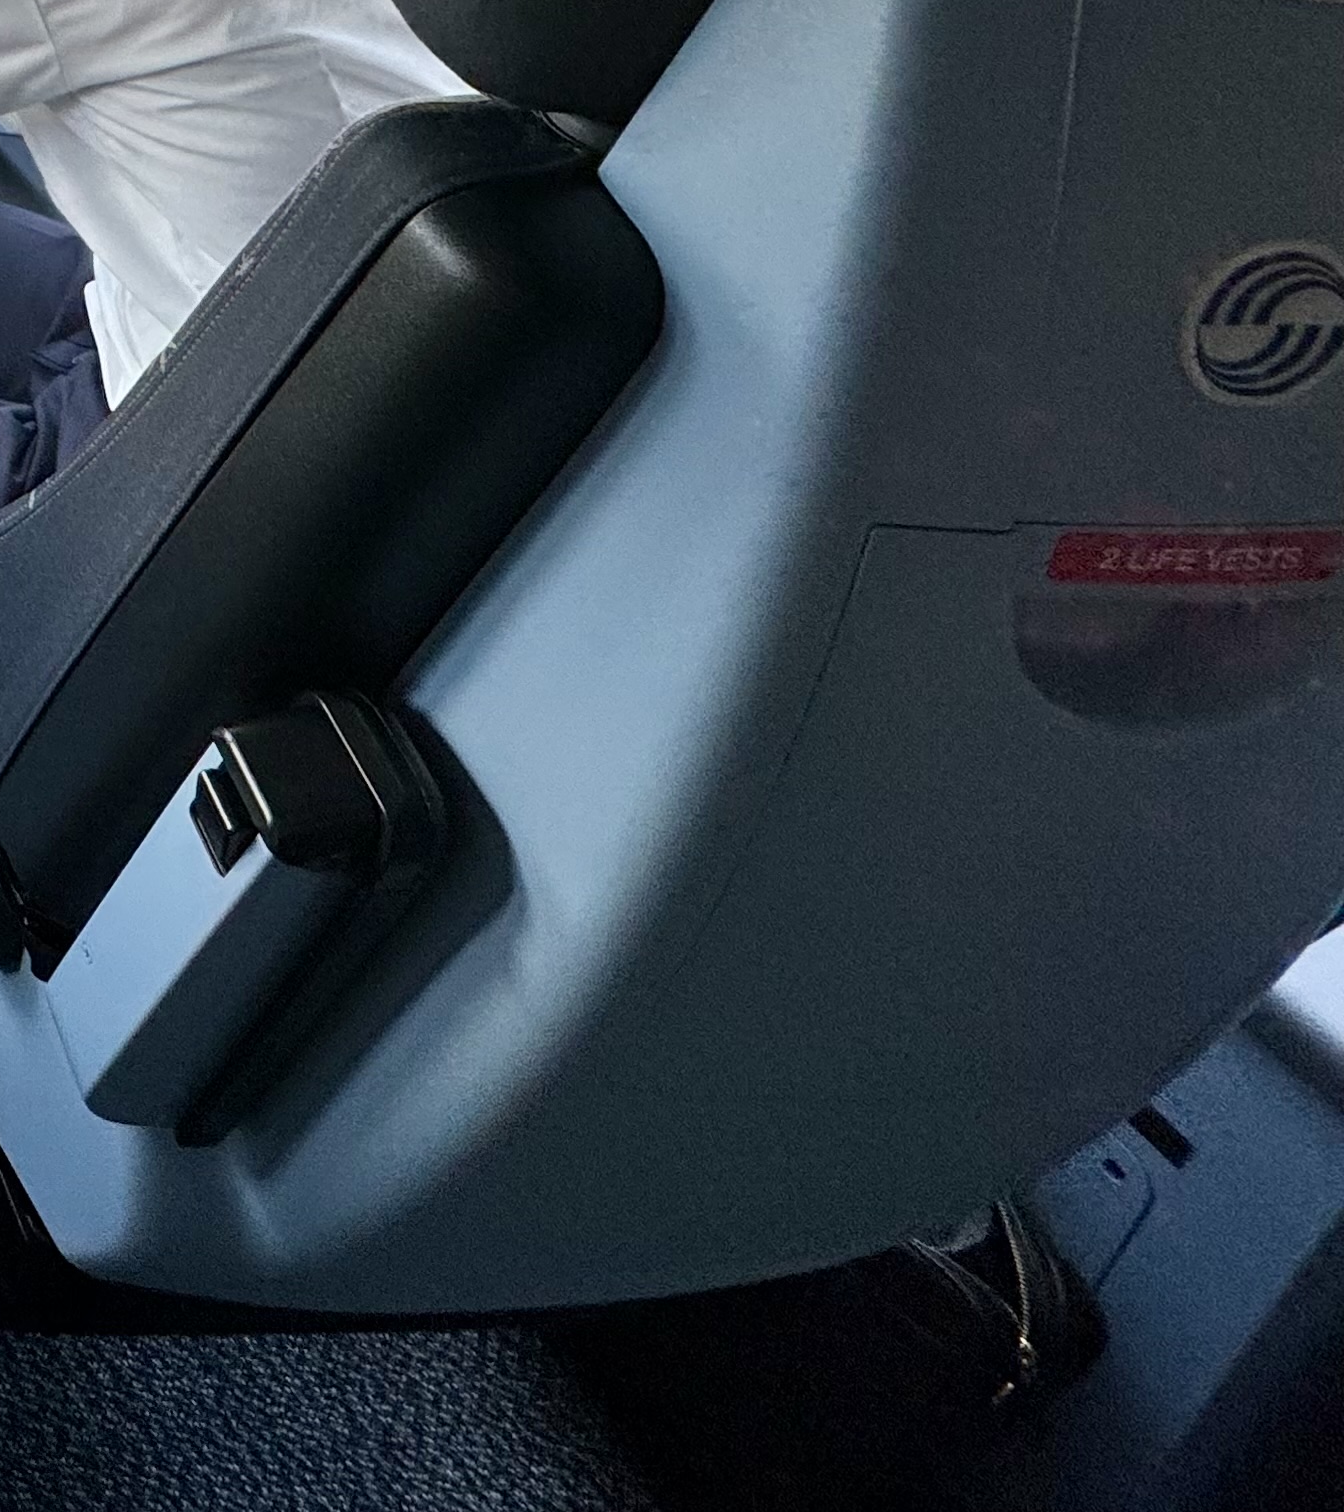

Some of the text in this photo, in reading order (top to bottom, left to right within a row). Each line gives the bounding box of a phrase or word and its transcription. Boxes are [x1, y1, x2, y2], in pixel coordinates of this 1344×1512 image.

[1098, 544, 1305, 571] 2 LIFE VESTS
